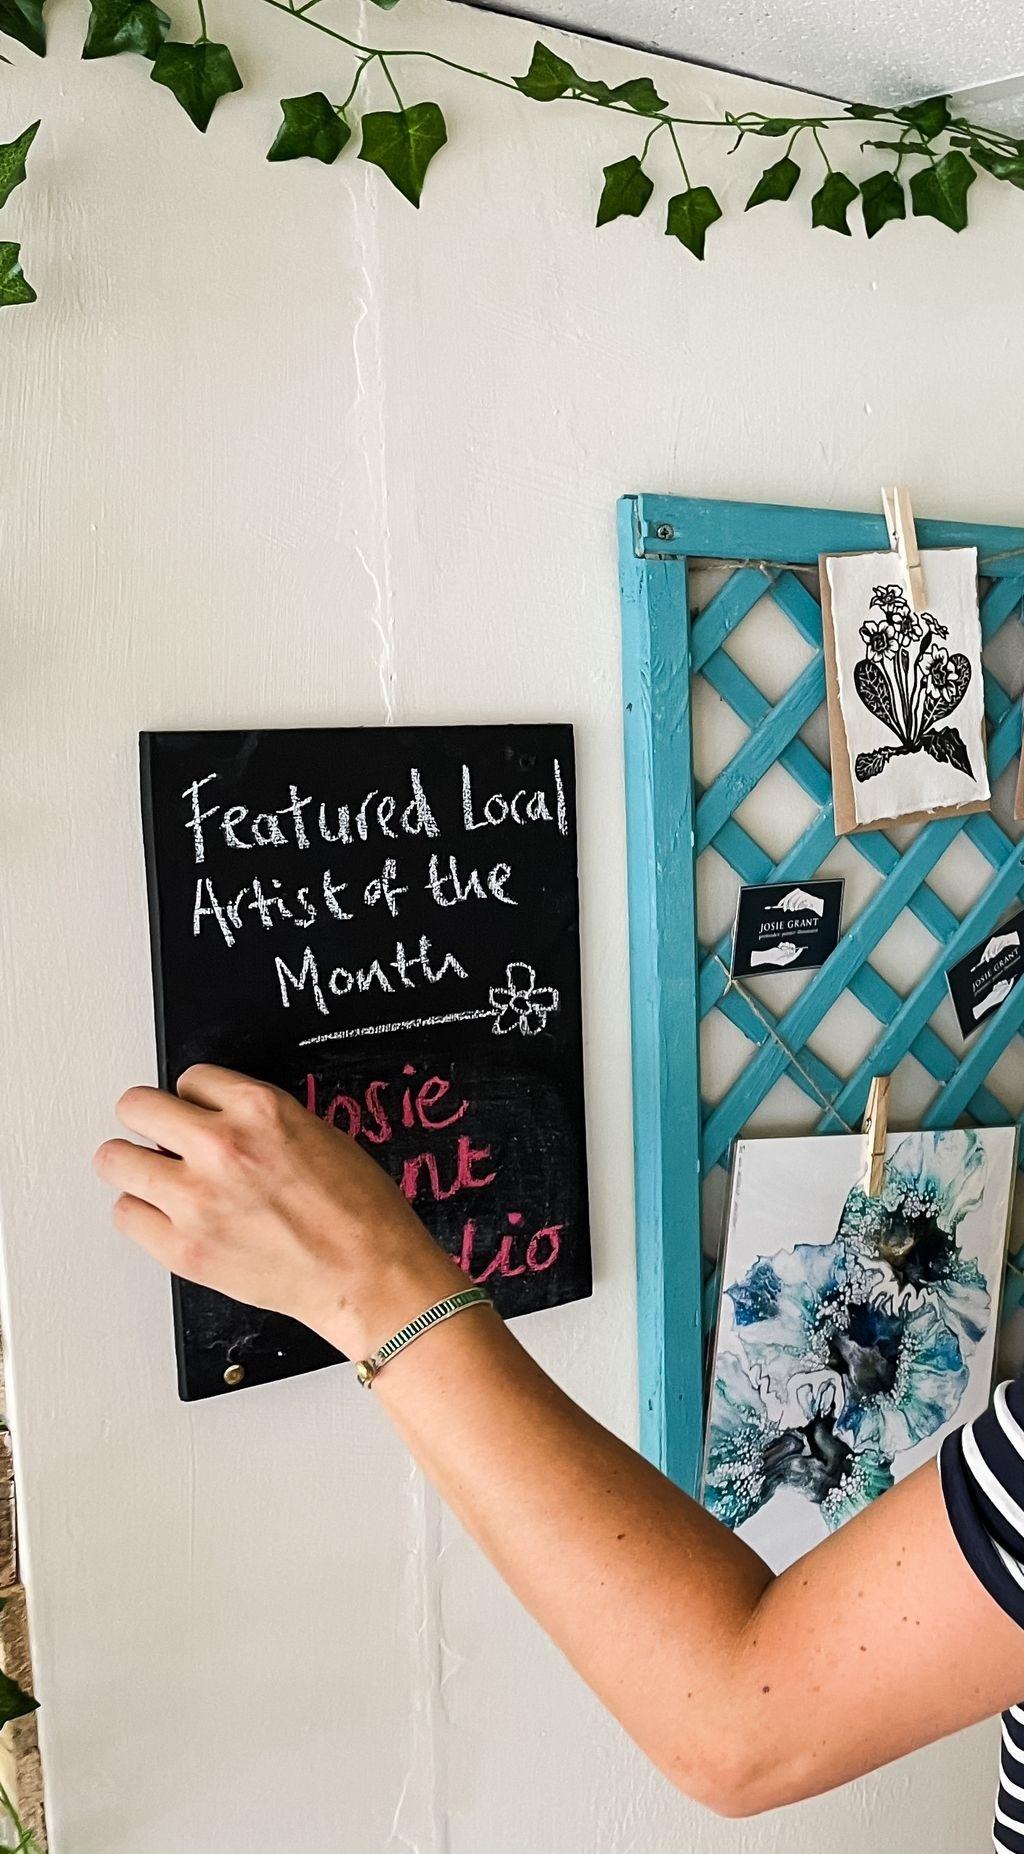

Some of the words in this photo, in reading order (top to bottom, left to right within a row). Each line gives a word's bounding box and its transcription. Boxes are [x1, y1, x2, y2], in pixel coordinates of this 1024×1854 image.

[182, 768, 440, 863] Featured
[462, 759, 568, 836] Local
[194, 870, 353, 947] Artist
[364, 858, 409, 917] of
[424, 854, 518, 907] the
[759, 920, 784, 934] JOSIE
[787, 917, 819, 929] GRANT
[274, 935, 469, 1014] Month
[972, 970, 993, 992] JOSIE
[994, 947, 1020, 973] GRANT
